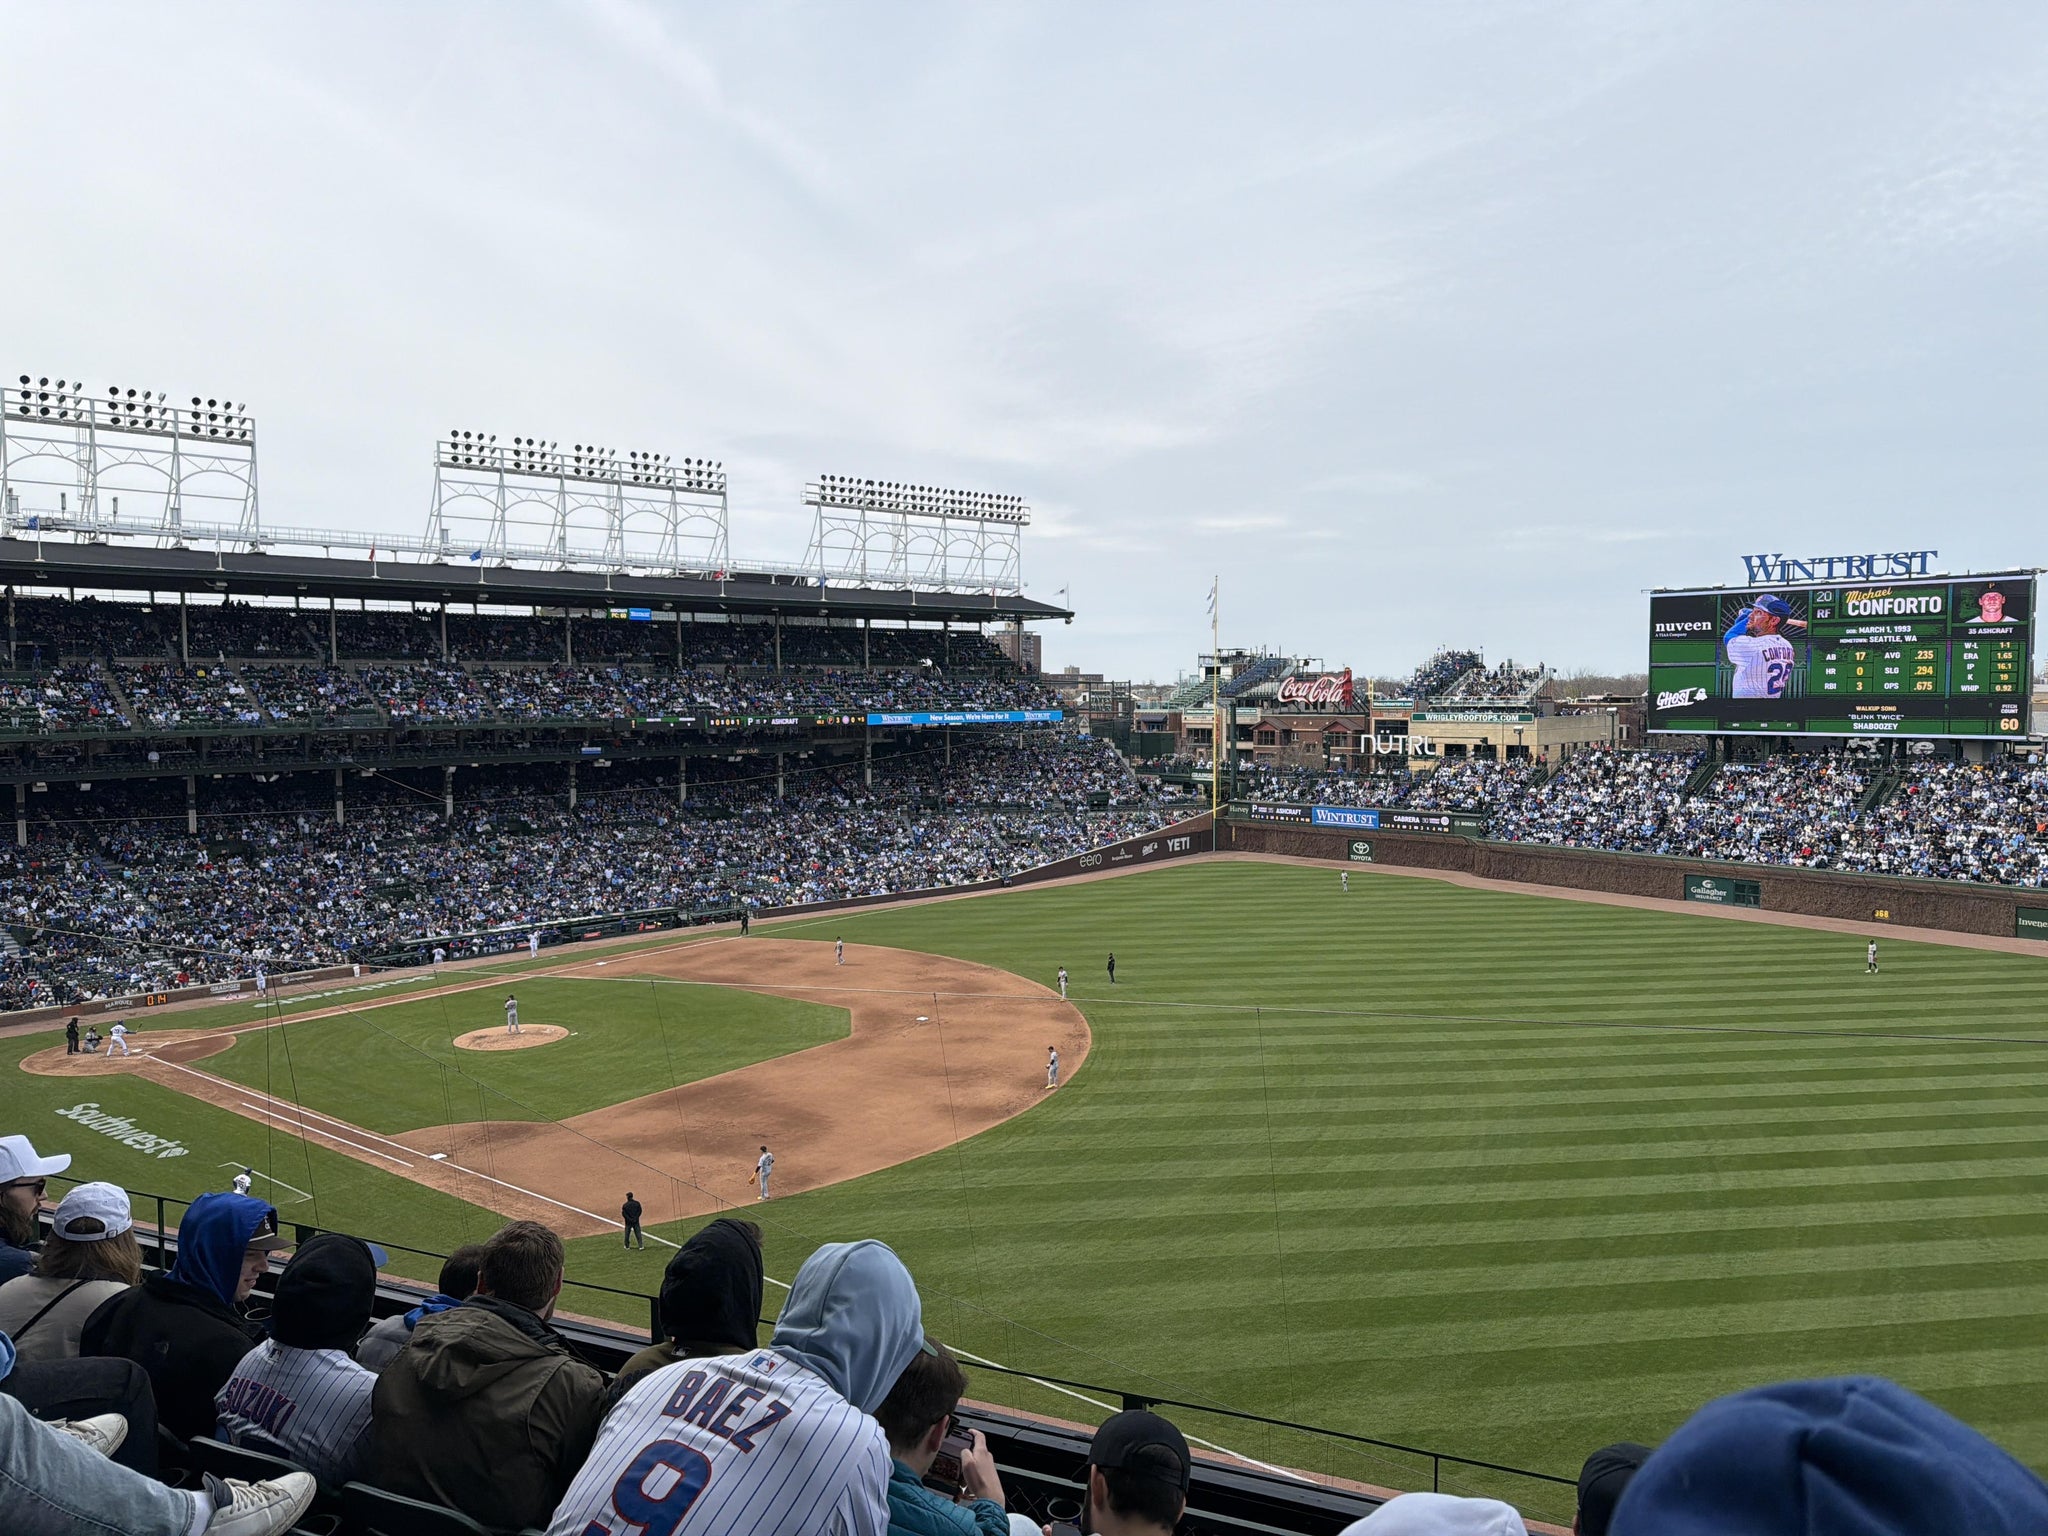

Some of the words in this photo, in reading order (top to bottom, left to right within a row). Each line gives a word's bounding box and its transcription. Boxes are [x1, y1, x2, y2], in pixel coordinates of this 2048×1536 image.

[1741, 550, 1938, 583] WINTRUST
[1816, 591, 1832, 603] 20
[1845, 587, 1893, 604] Michael
[1847, 596, 1942, 616] CONFORTO
[1816, 609, 1831, 618] RF
[1655, 621, 1712, 632] nuveen
[1859, 626, 1885, 634] MARCH
[1886, 626, 1893, 634] 1,
[1894, 625, 1911, 633] 1993
[1977, 627, 2014, 635] ASHCRAFT
[1869, 635, 1903, 643] SEATTLE,
[1855, 652, 1866, 660] 17
[1914, 651, 1934, 659] .235
[1856, 667, 1864, 676] 0
[1885, 667, 1900, 675] SLG
[1914, 666, 1933, 675] .294
[1278, 676, 1345, 705] Coca-Cola
[1856, 682, 1863, 691] 3
[1914, 682, 1933, 690] .675
[1656, 687, 1698, 710] GHOST
[771, 717, 799, 725] ASHCRAFT
[944, 713, 965, 722] Season,
[1853, 722, 1899, 730] SHABOOZEY
[2000, 718, 2019, 730] 60
[1229, 805, 1250, 815] Harvey
[1315, 809, 1377, 824] WINTRUST
[1393, 815, 1420, 823] CABRERA
[1167, 837, 1190, 852] YETI
[1079, 853, 1102, 867] eero
[1690, 886, 1727, 897] Gallagher
[1874, 909, 1889, 918] 368
[2018, 917, 2048, 928] Invene
[105, 1000, 133, 1009] MARQUEE
[54, 1102, 182, 1154] Southwest
[216, 1377, 297, 1438] SUZUKI
[661, 1370, 793, 1455] BAEZ
[580, 1438, 713, 1536] 9
